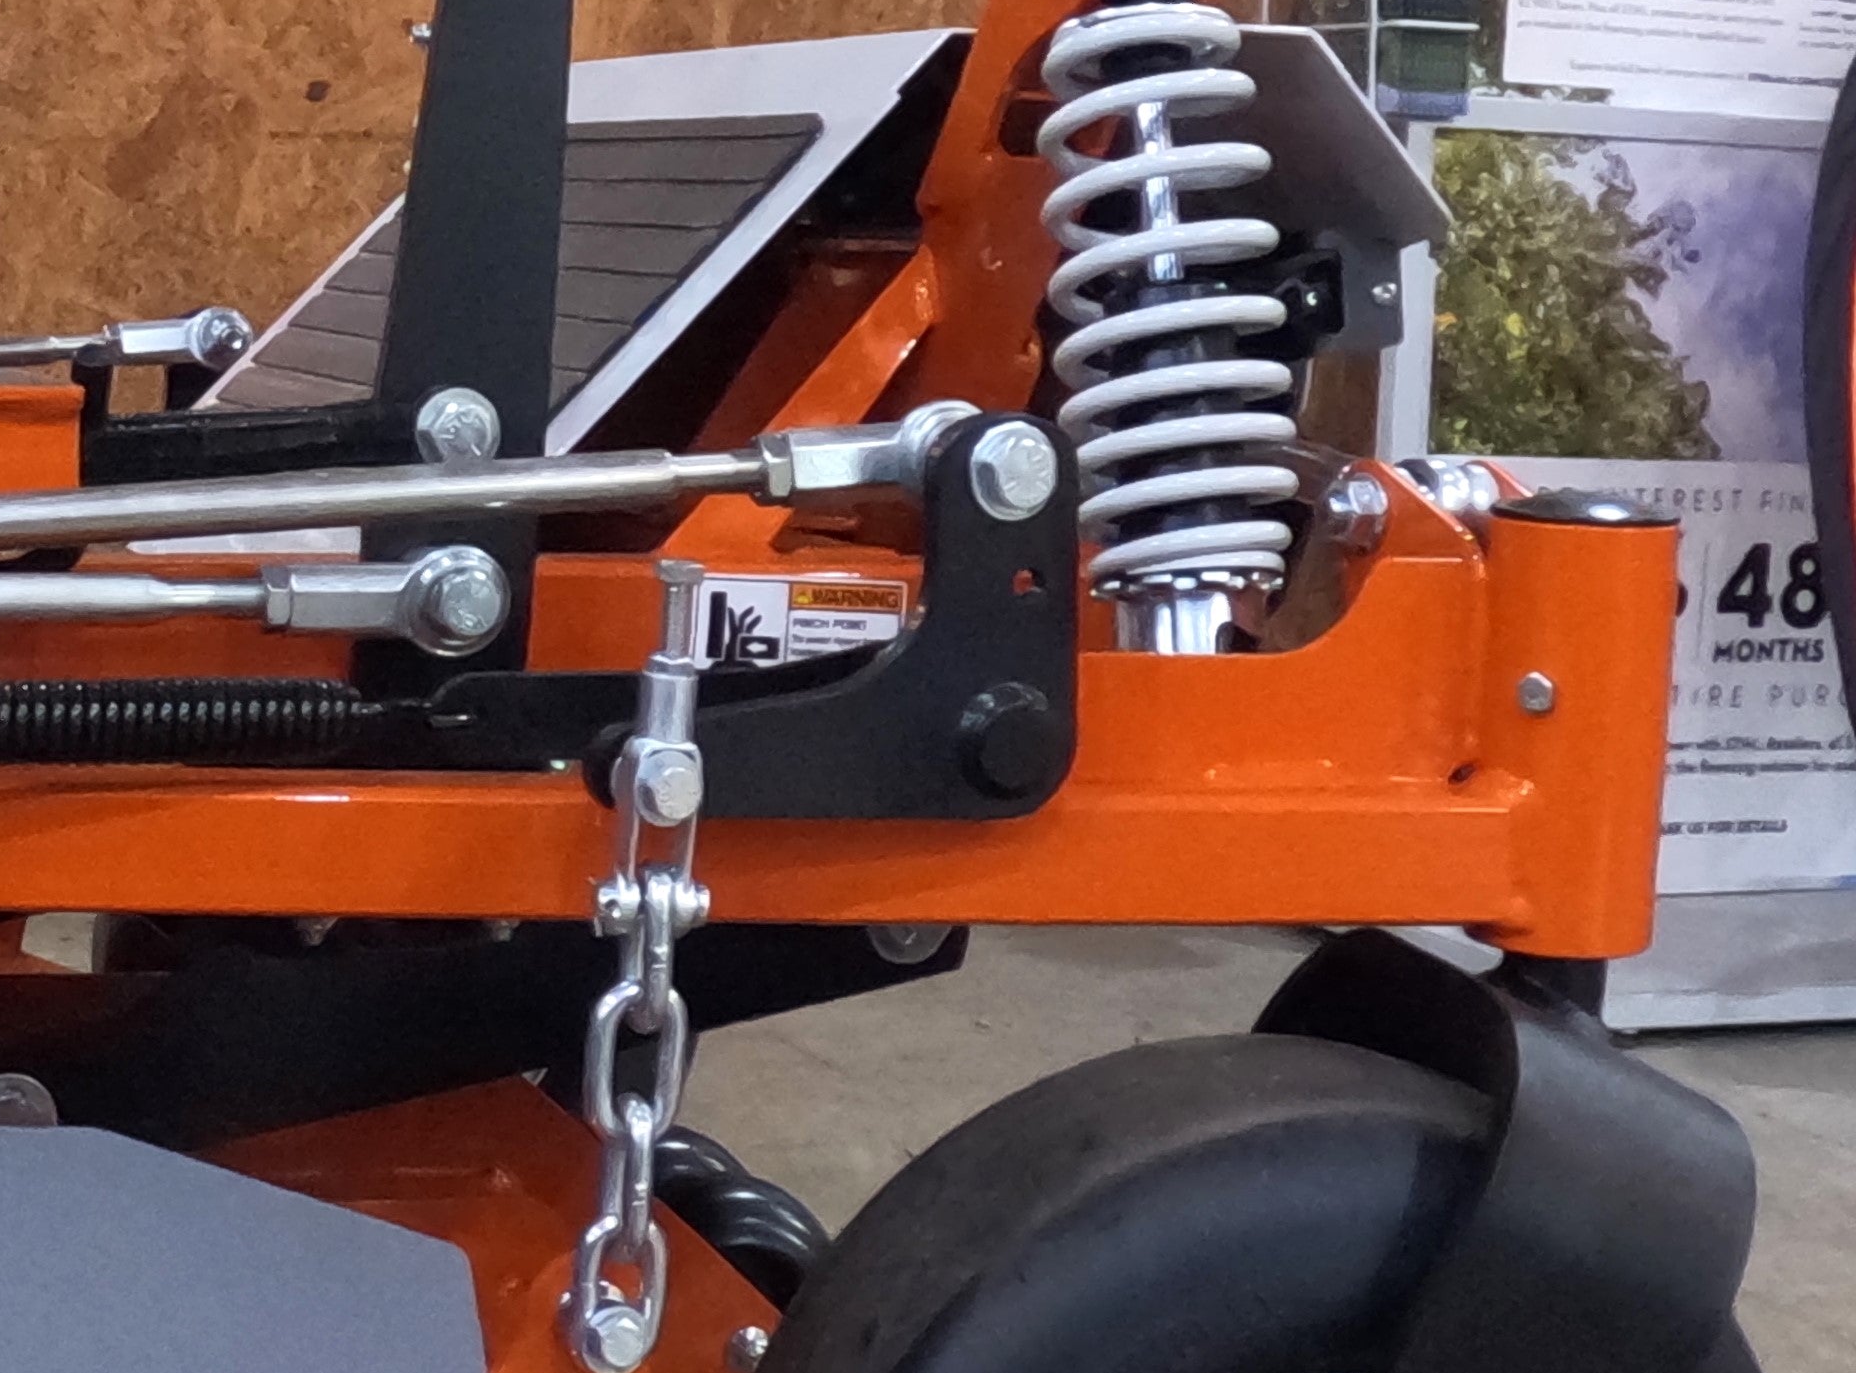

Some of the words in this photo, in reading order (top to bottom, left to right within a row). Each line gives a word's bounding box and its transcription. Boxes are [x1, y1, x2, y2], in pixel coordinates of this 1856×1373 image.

[1608, 485, 1743, 514] TEREST
[812, 588, 900, 609] WARNING
[1716, 541, 1828, 629] 48
[1711, 637, 1825, 664] MONTHS
